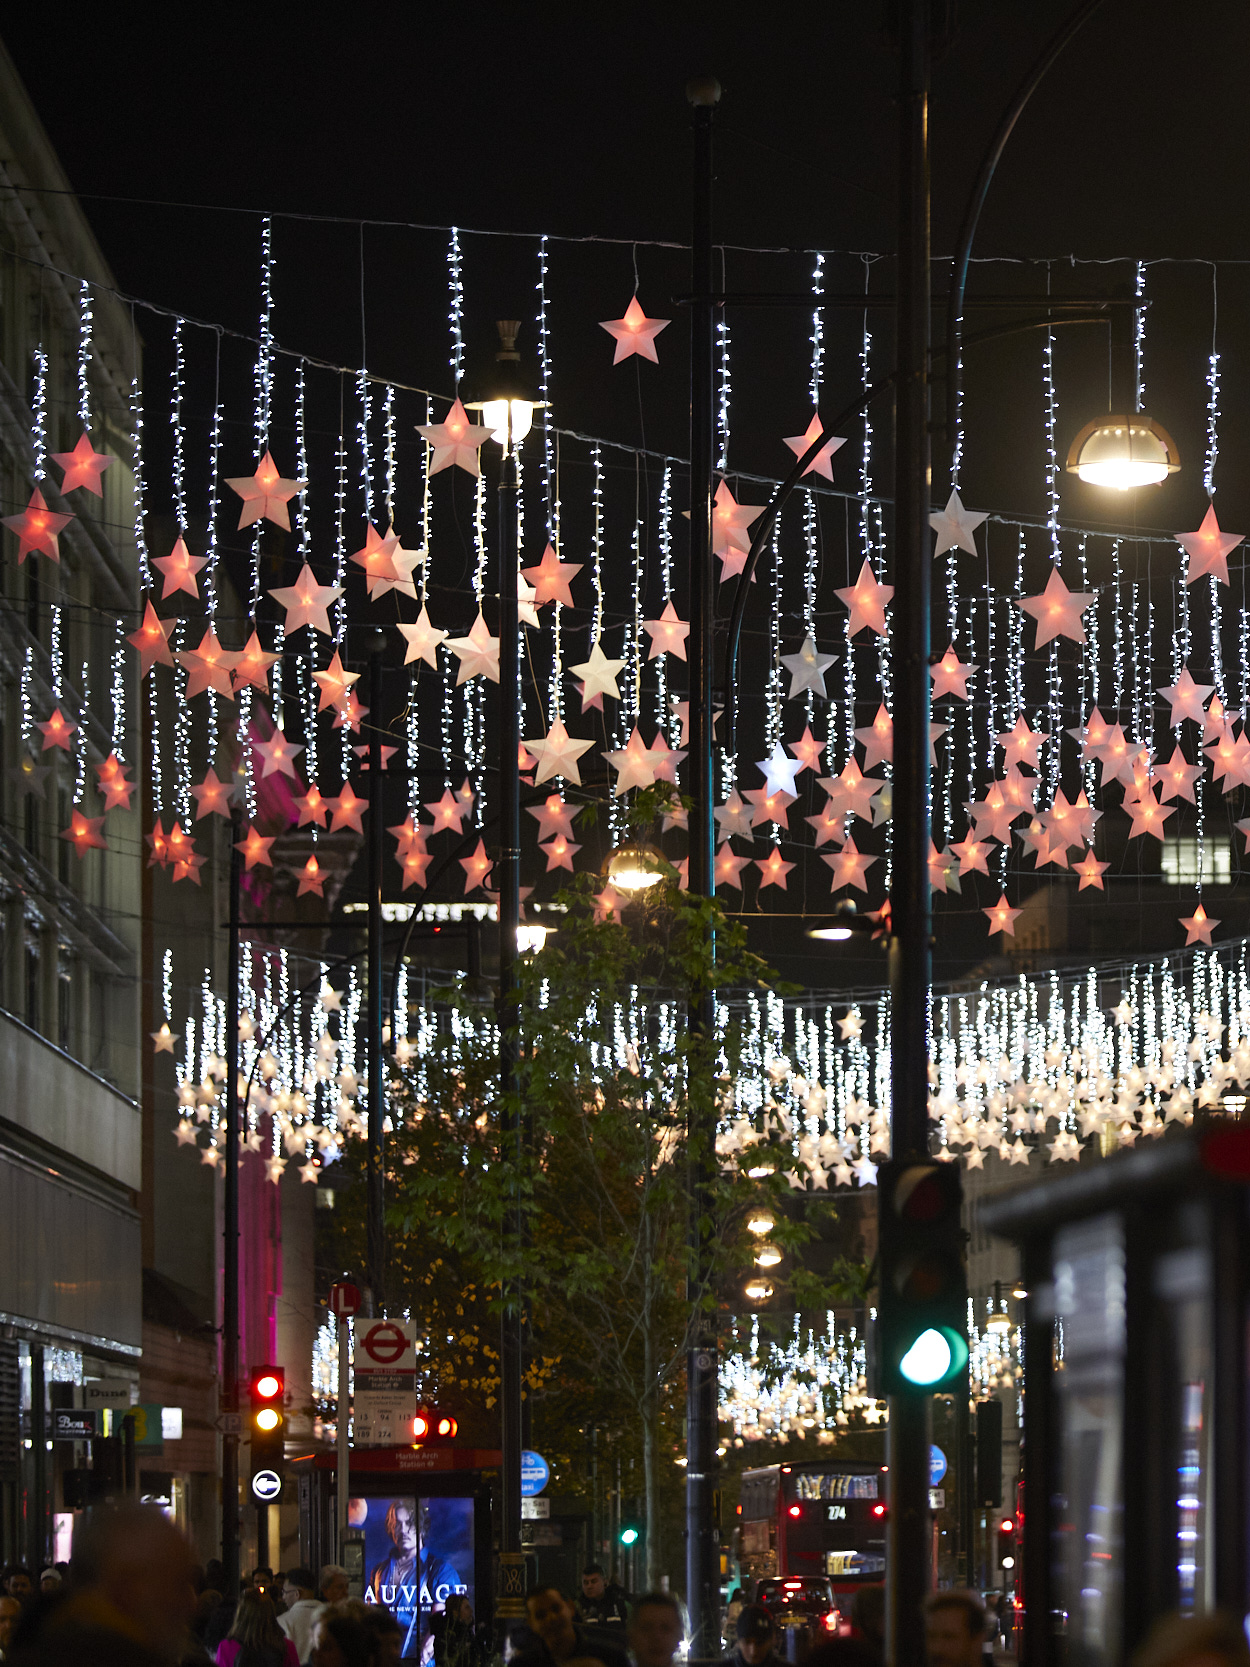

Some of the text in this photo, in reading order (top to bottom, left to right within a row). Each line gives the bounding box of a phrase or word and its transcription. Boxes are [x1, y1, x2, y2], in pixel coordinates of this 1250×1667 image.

[338, 1287, 354, 1312] L
[90, 1388, 127, 1398] Dune
[380, 1413, 389, 1421] 94
[421, 1452, 439, 1460] Arch
[827, 1505, 847, 1520] 274
